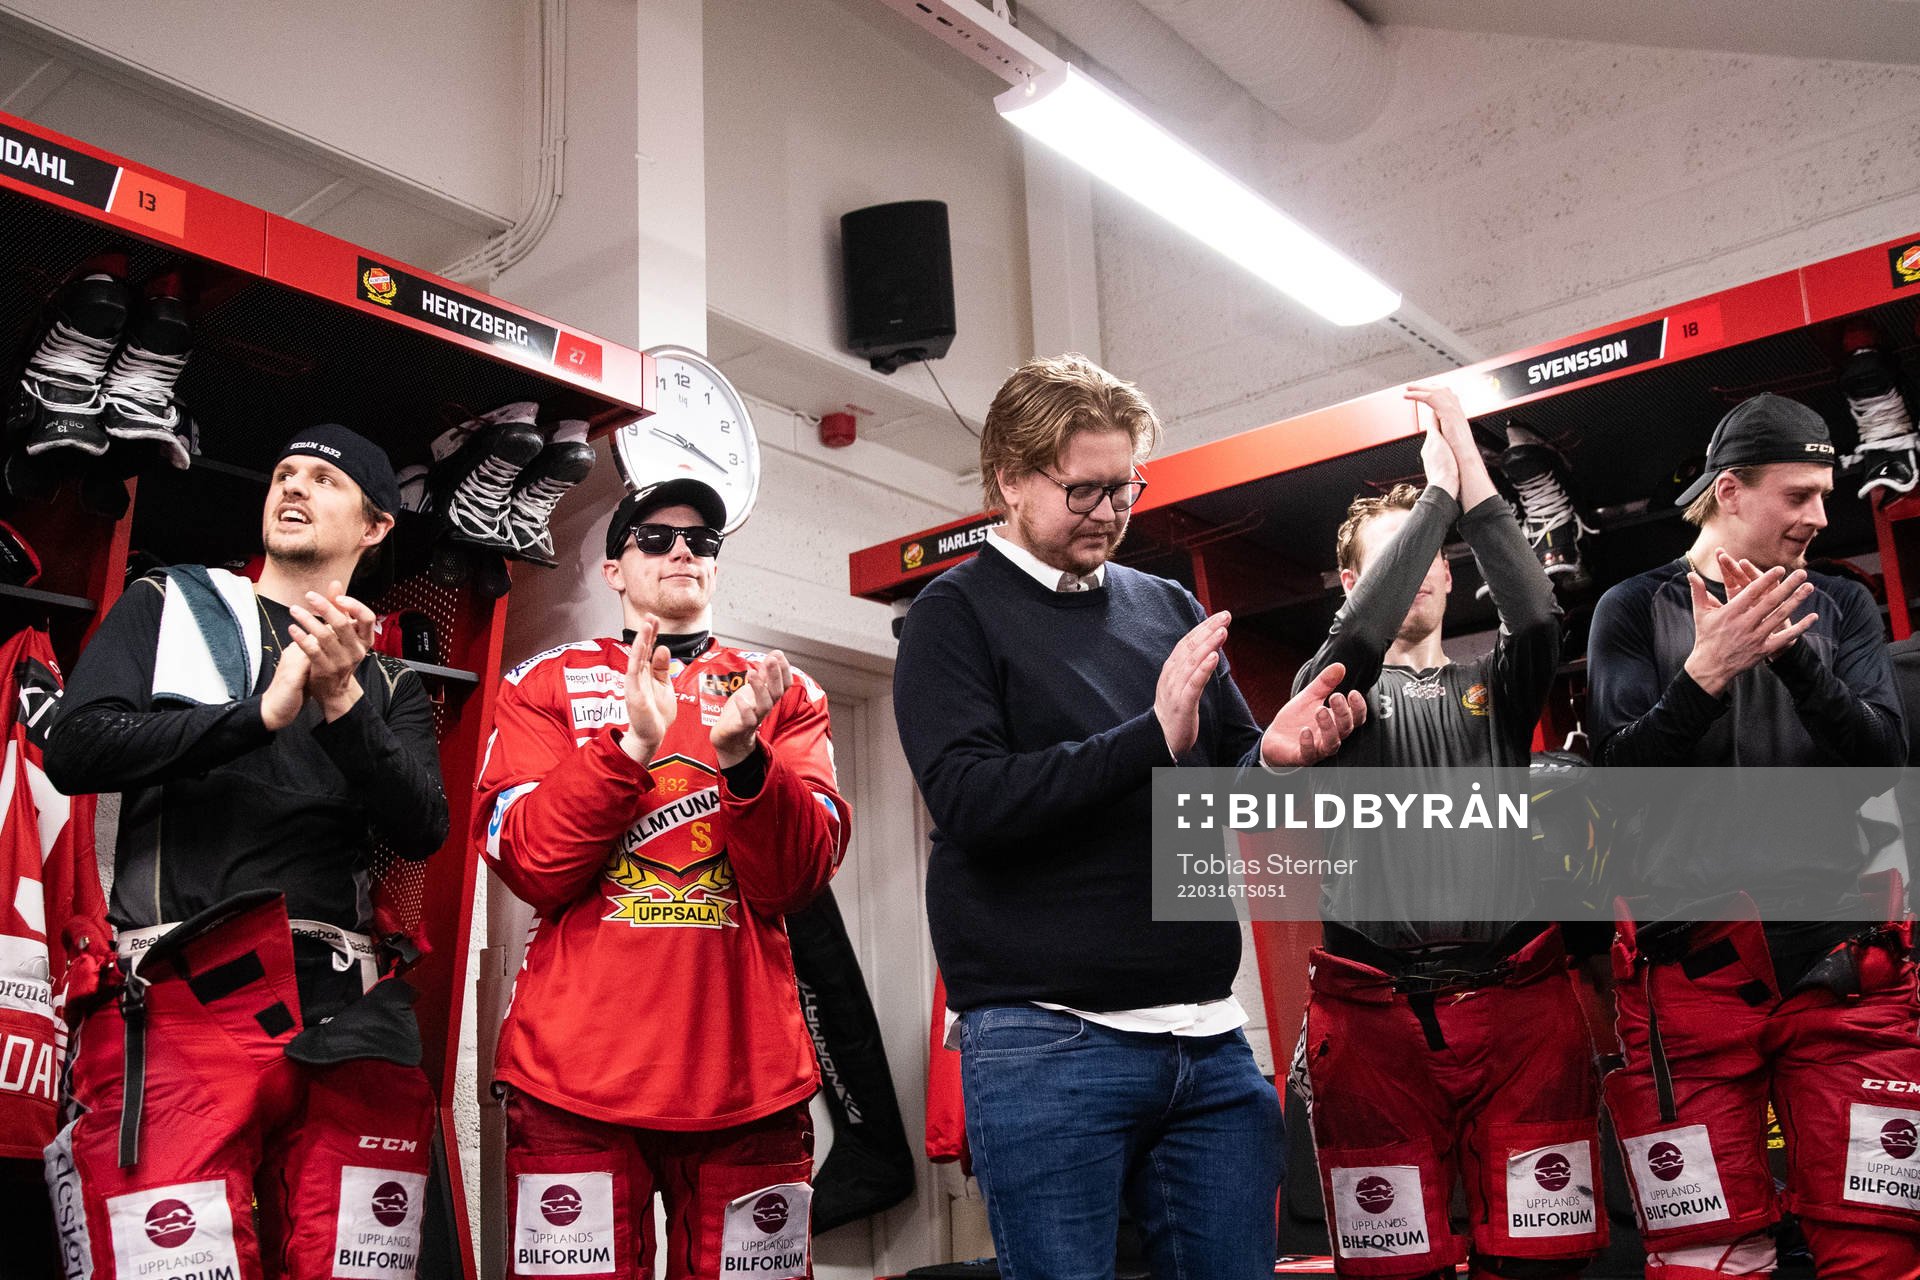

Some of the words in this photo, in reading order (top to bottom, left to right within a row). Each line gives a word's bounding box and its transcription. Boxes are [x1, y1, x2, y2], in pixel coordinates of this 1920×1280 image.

[0, 136, 75, 186] DAHL
[138, 190, 156, 212] 13
[422, 290, 528, 347] HERTZBERG
[1682, 323, 1699, 338] 18
[569, 347, 585, 365] 27
[1528, 340, 1628, 385] SVENSSON
[674, 373, 691, 389] 12
[720, 420, 731, 434] 2
[728, 453, 739, 466] 3
[627, 790, 720, 849] ALMTUNA
[690, 821, 713, 853] S
[638, 906, 716, 922] UPPSALA
[130, 933, 161, 951] Ree
[358, 1135, 418, 1153] CCM
[1650, 1182, 1701, 1200] UPPLANDS
[1850, 1175, 1920, 1200] BILFORU
[1527, 1195, 1580, 1209] UPPLANDS
[1645, 1195, 1722, 1221] BILFORUM
[1351, 1217, 1408, 1231] UPPLANDS
[1513, 1208, 1593, 1228] BILFORUM
[358, 1232, 411, 1248] UPPLANDS
[532, 1232, 593, 1244] UPPLANDS
[741, 1238, 794, 1252] UPPLANDS
[1341, 1230, 1425, 1249] BILFORUM
[138, 1250, 214, 1275] UPPLANDS
[339, 1249, 416, 1271] BILFORUM
[519, 1247, 610, 1265] BILFORUM
[725, 1251, 804, 1271] BILFORUM
